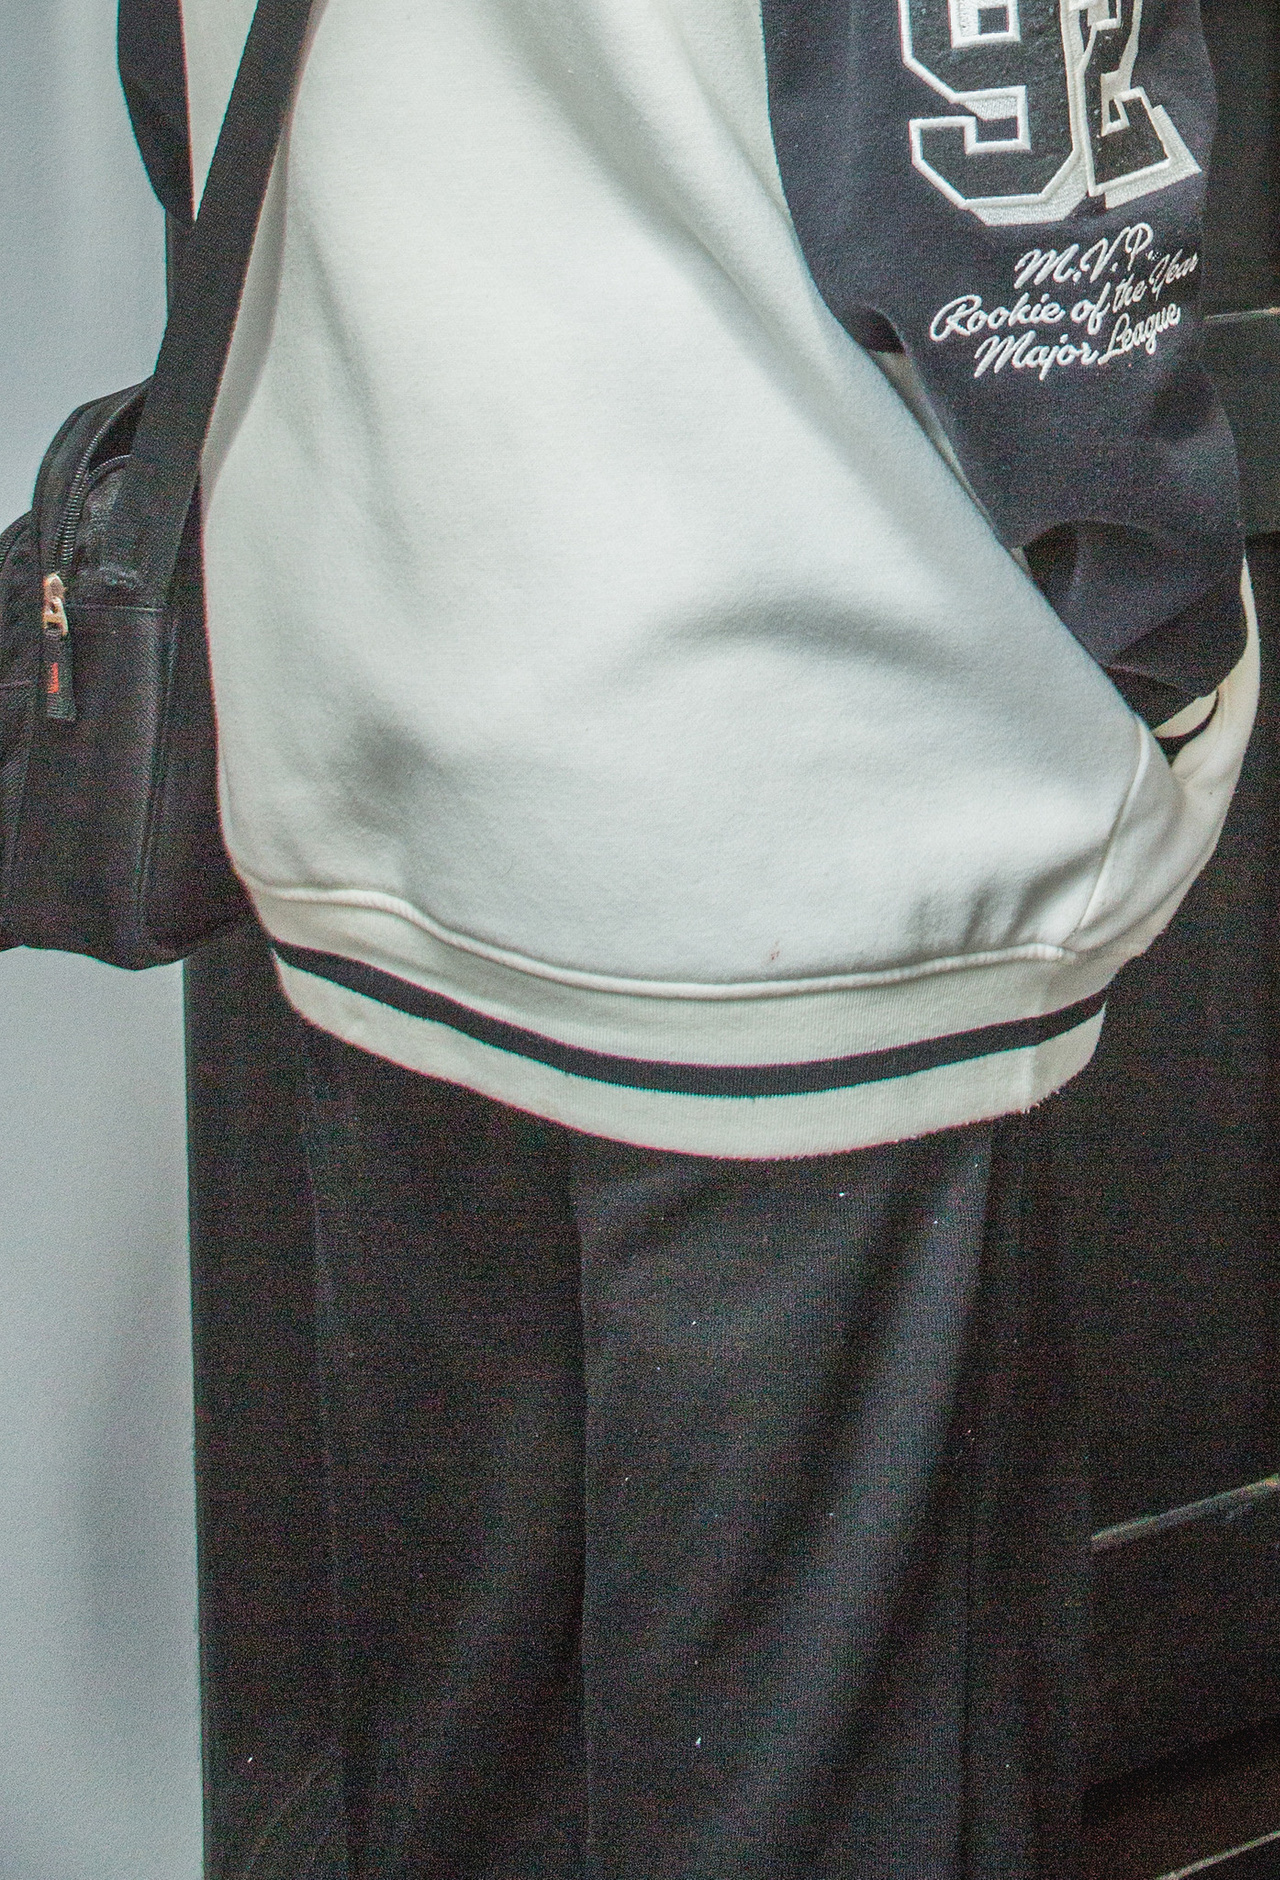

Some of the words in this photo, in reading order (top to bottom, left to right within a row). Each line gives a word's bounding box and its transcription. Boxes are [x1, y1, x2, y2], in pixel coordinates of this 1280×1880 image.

[929, 292, 1064, 344] Rookie
[1071, 282, 1117, 339] of
[1112, 275, 1148, 314] the
[1149, 249, 1199, 302] Year
[972, 334, 1099, 382] Major
[1097, 302, 1182, 366] League
